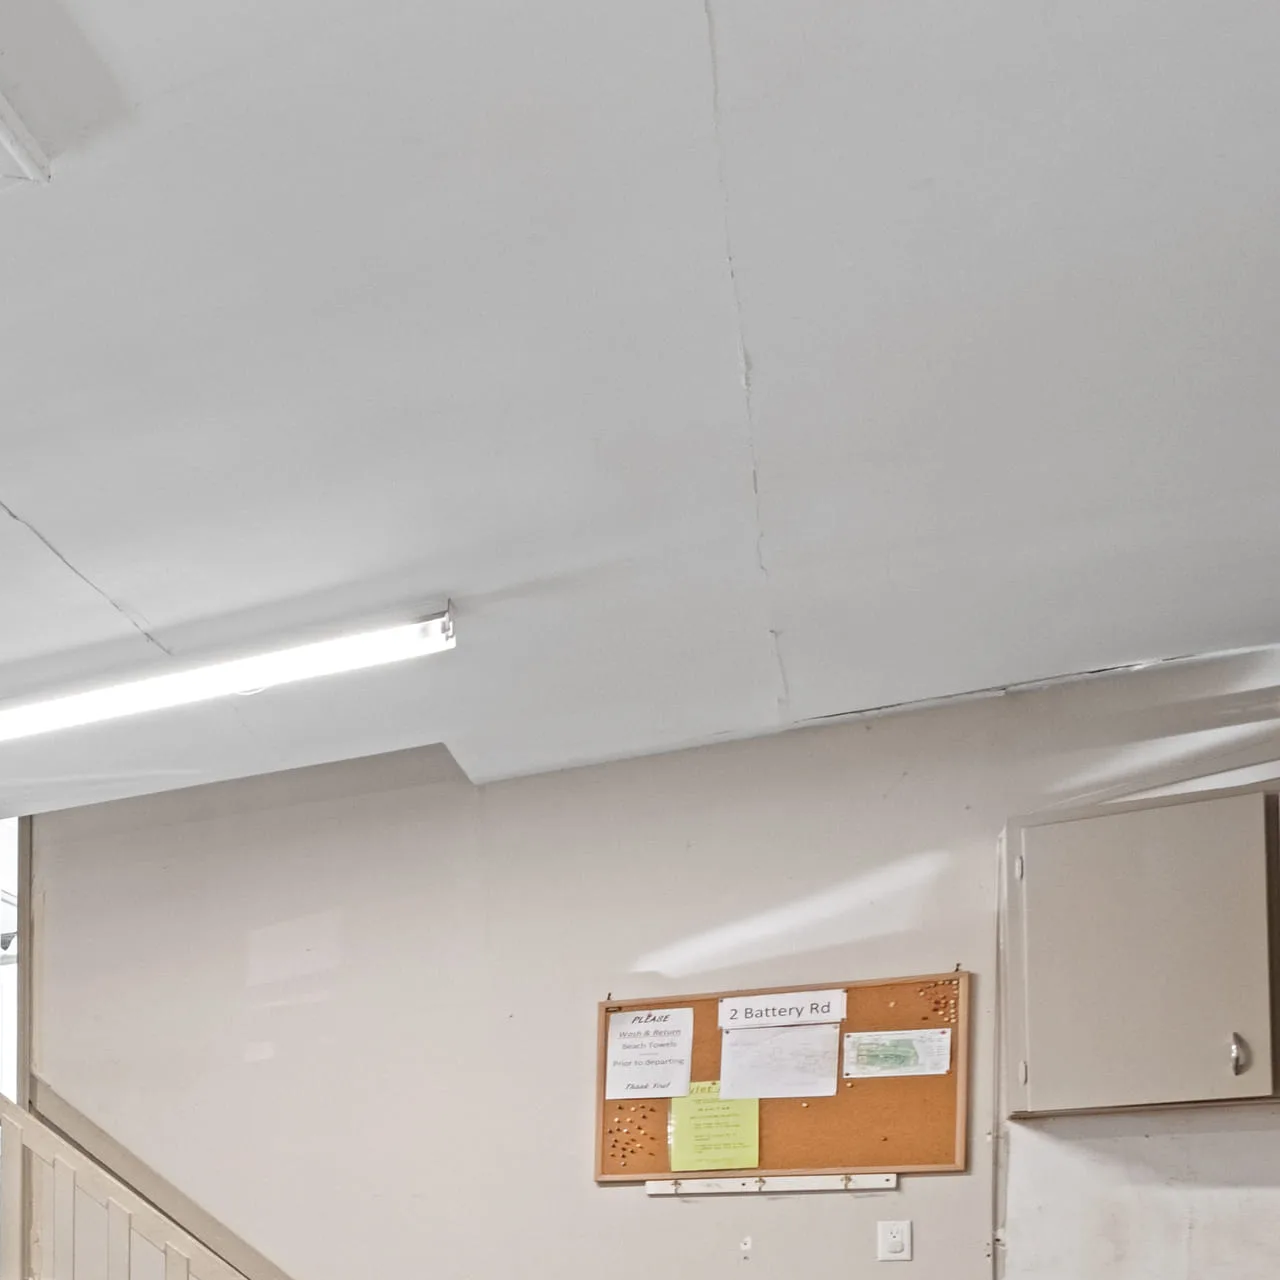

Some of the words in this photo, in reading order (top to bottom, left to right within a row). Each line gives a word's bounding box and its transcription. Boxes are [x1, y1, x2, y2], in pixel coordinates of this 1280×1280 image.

[729, 1008, 739, 1020] 2
[744, 1004, 805, 1019] Battery
[810, 1001, 831, 1014] Rd
[632, 1014, 671, 1023] PLEASE
[653, 1029, 681, 1037] Return
[649, 1040, 677, 1049] Towels
